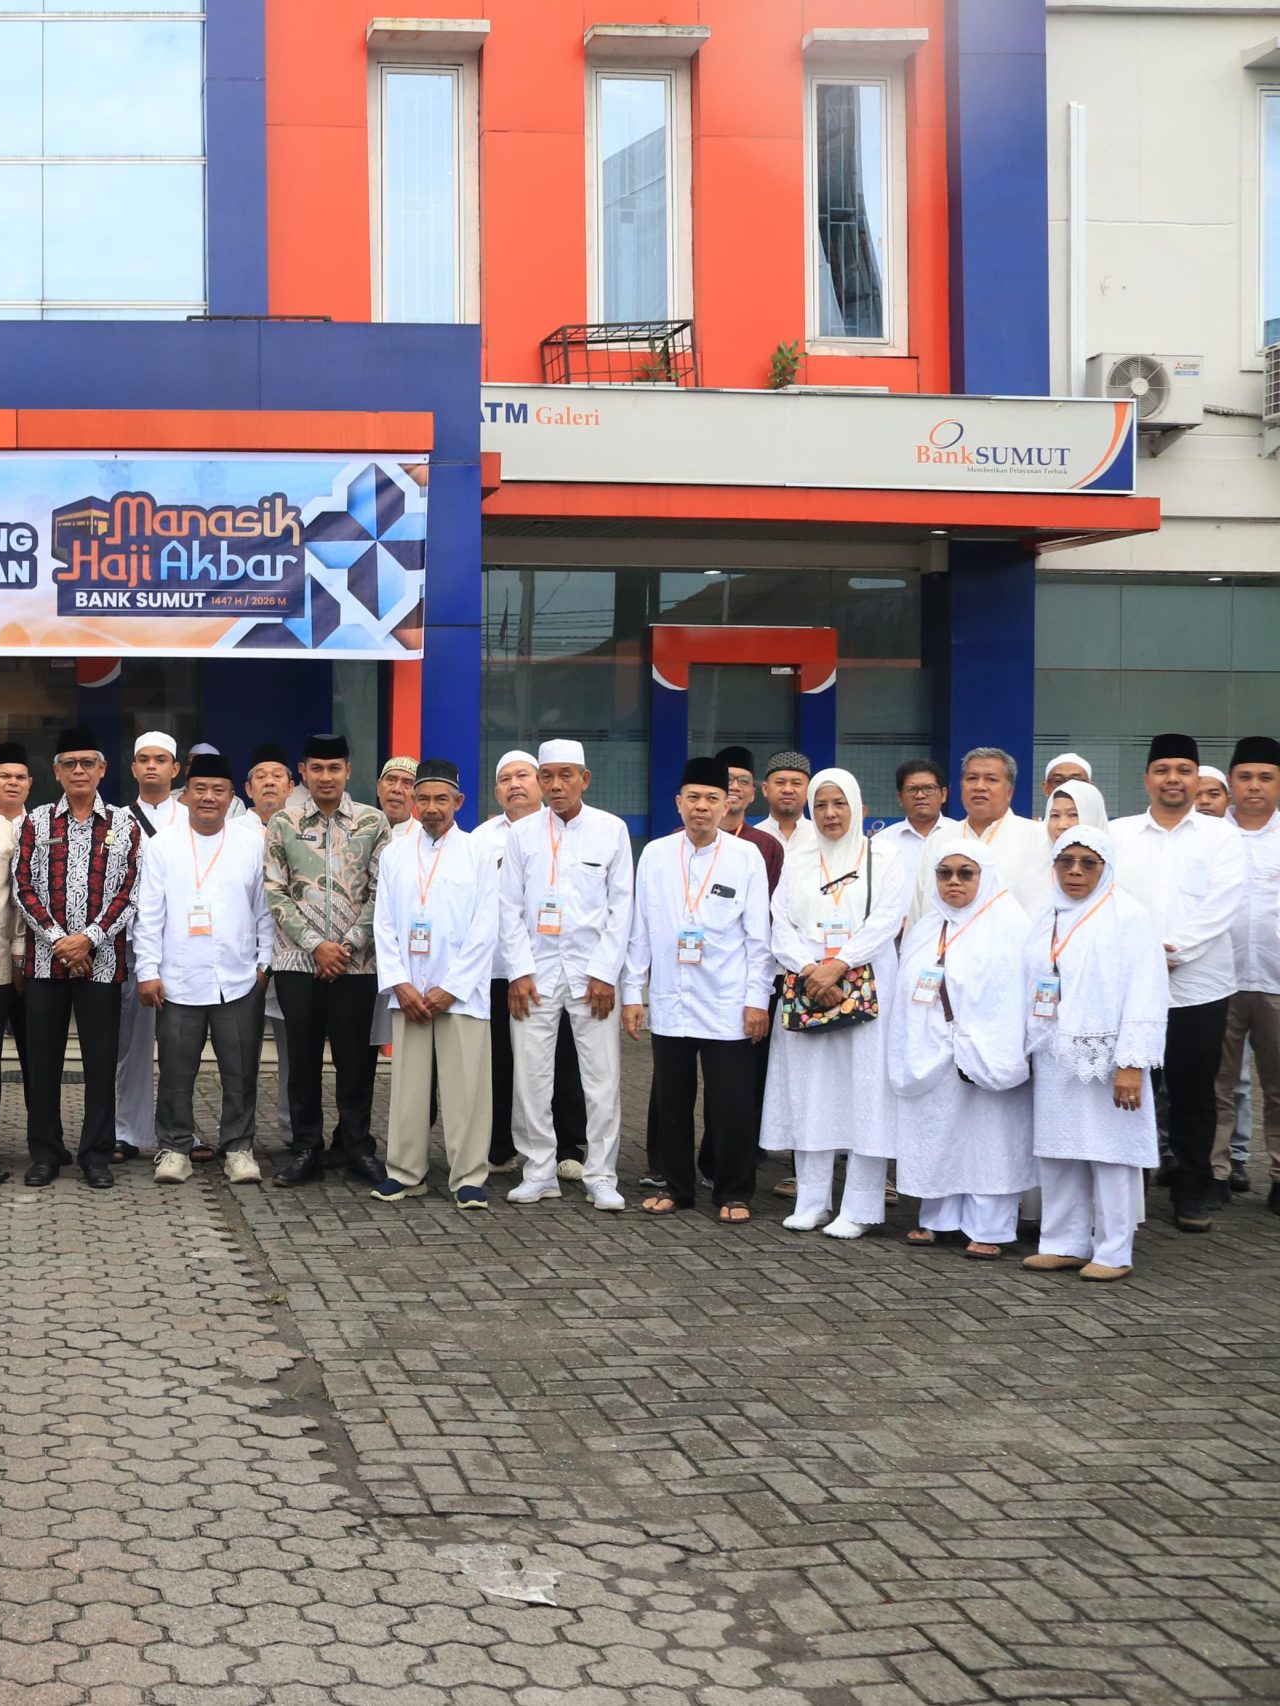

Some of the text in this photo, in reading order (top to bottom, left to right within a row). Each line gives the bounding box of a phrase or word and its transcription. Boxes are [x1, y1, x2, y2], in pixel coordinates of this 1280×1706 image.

[480, 402, 600, 426] TM Galeri
[1009, 467, 1042, 475] Pelayanan
[105, 496, 300, 546] Manasik
[57, 540, 298, 588] Haji Akbar
[75, 591, 132, 608] BANK
[136, 591, 206, 608] SUMUT
[211, 596, 233, 605] 1447
[235, 596, 242, 605] H
[251, 596, 275, 605] 2026
[277, 597, 287, 605] M
